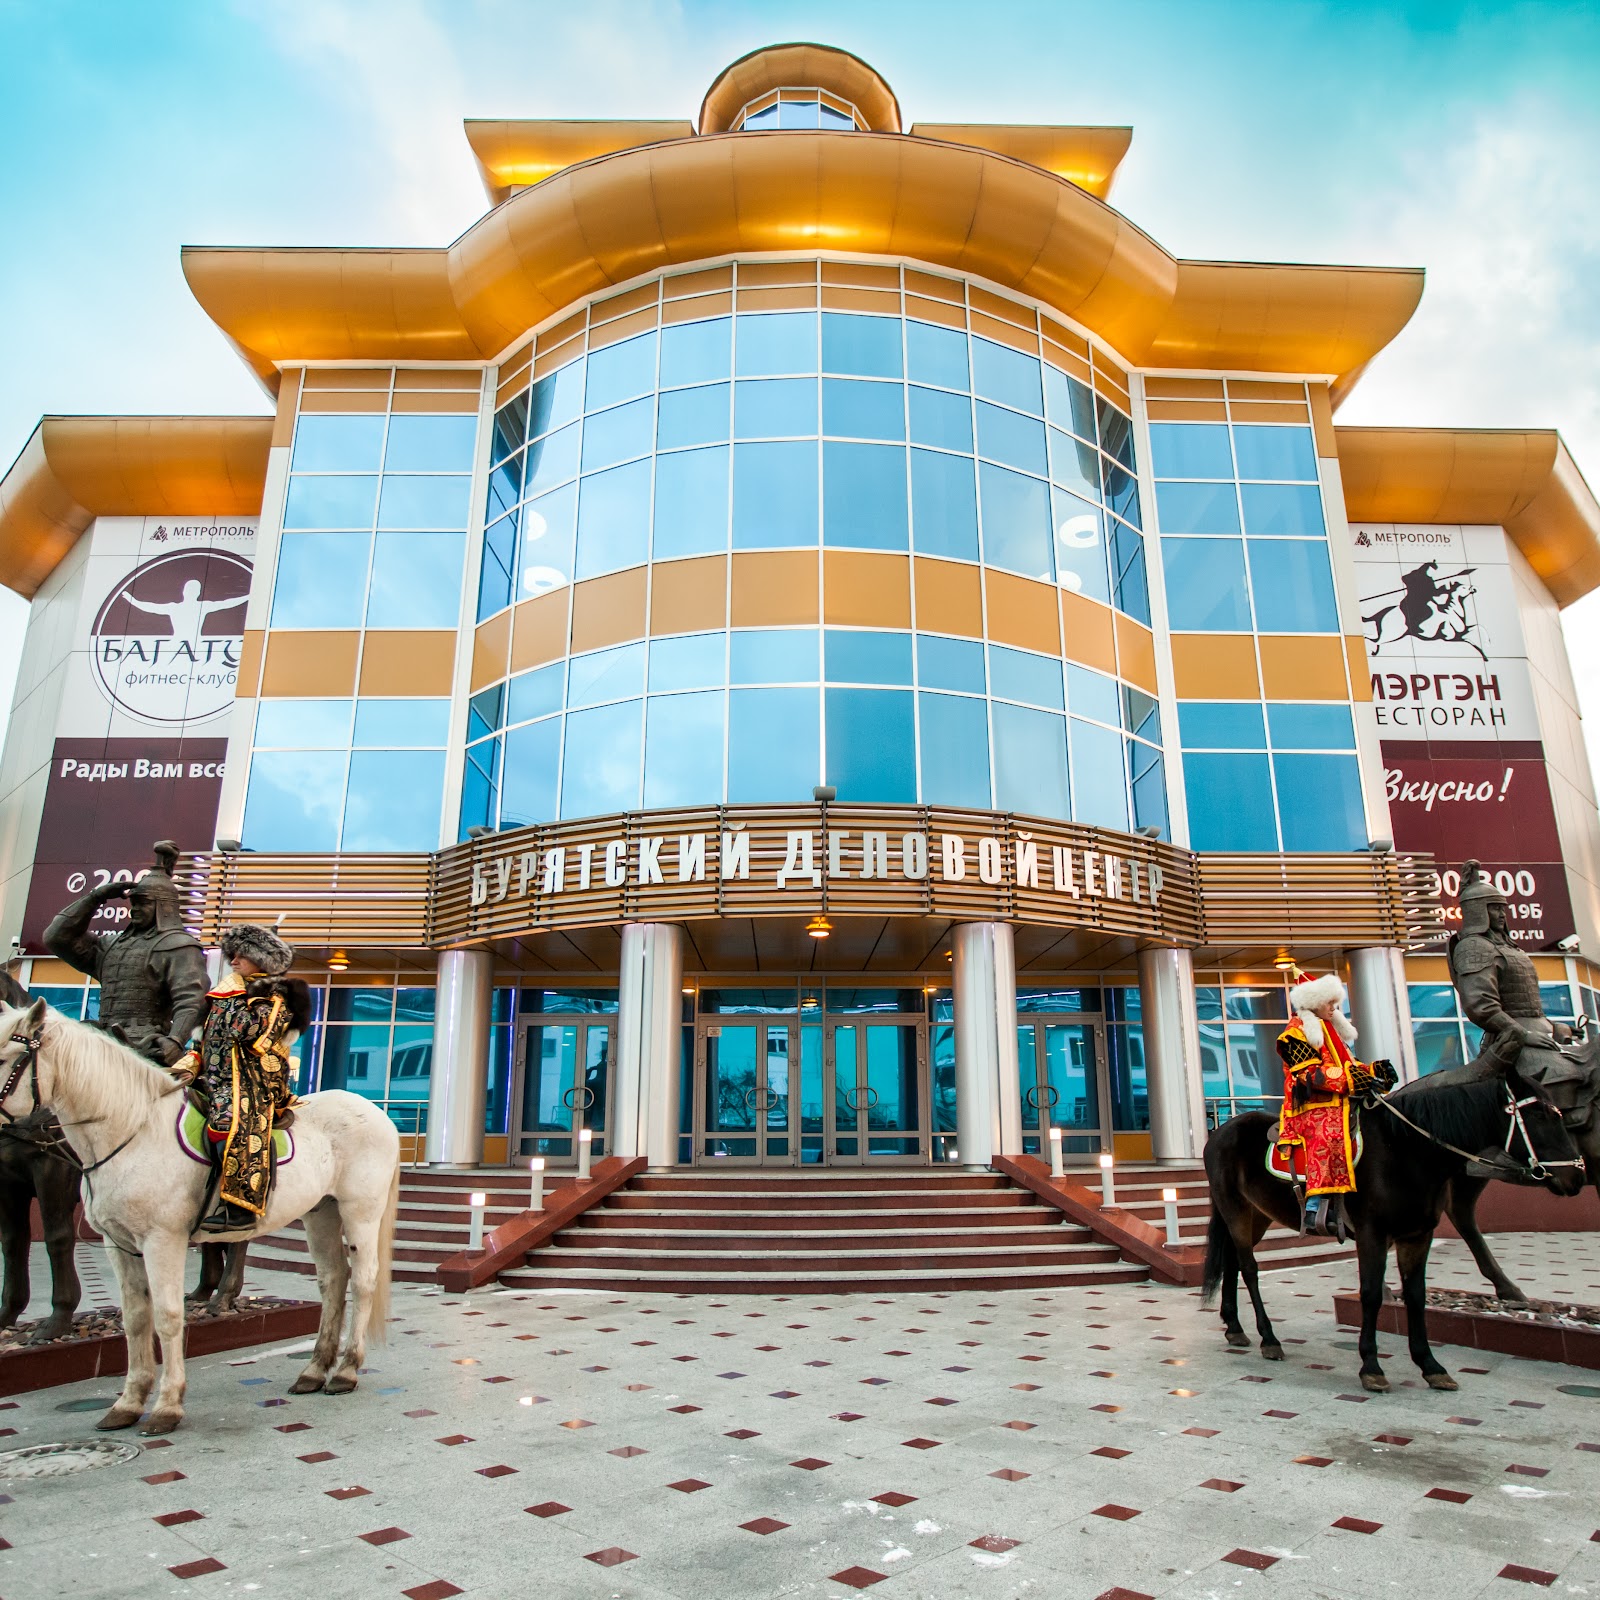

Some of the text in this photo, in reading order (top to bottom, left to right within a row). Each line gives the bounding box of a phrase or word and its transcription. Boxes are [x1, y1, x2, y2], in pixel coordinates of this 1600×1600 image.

[173, 526, 254, 537] МЕТРОПОЛЬ
[1375, 532, 1451, 544] МЕТРОПОЛЬ
[125, 670, 237, 688] фитнес-клуб
[60, 758, 129, 782] Рады
[133, 758, 183, 778] Вам
[470, 822, 1164, 906] БУРЯТСКИЙ ДЕЛОВОЙ ЦЕНТР
